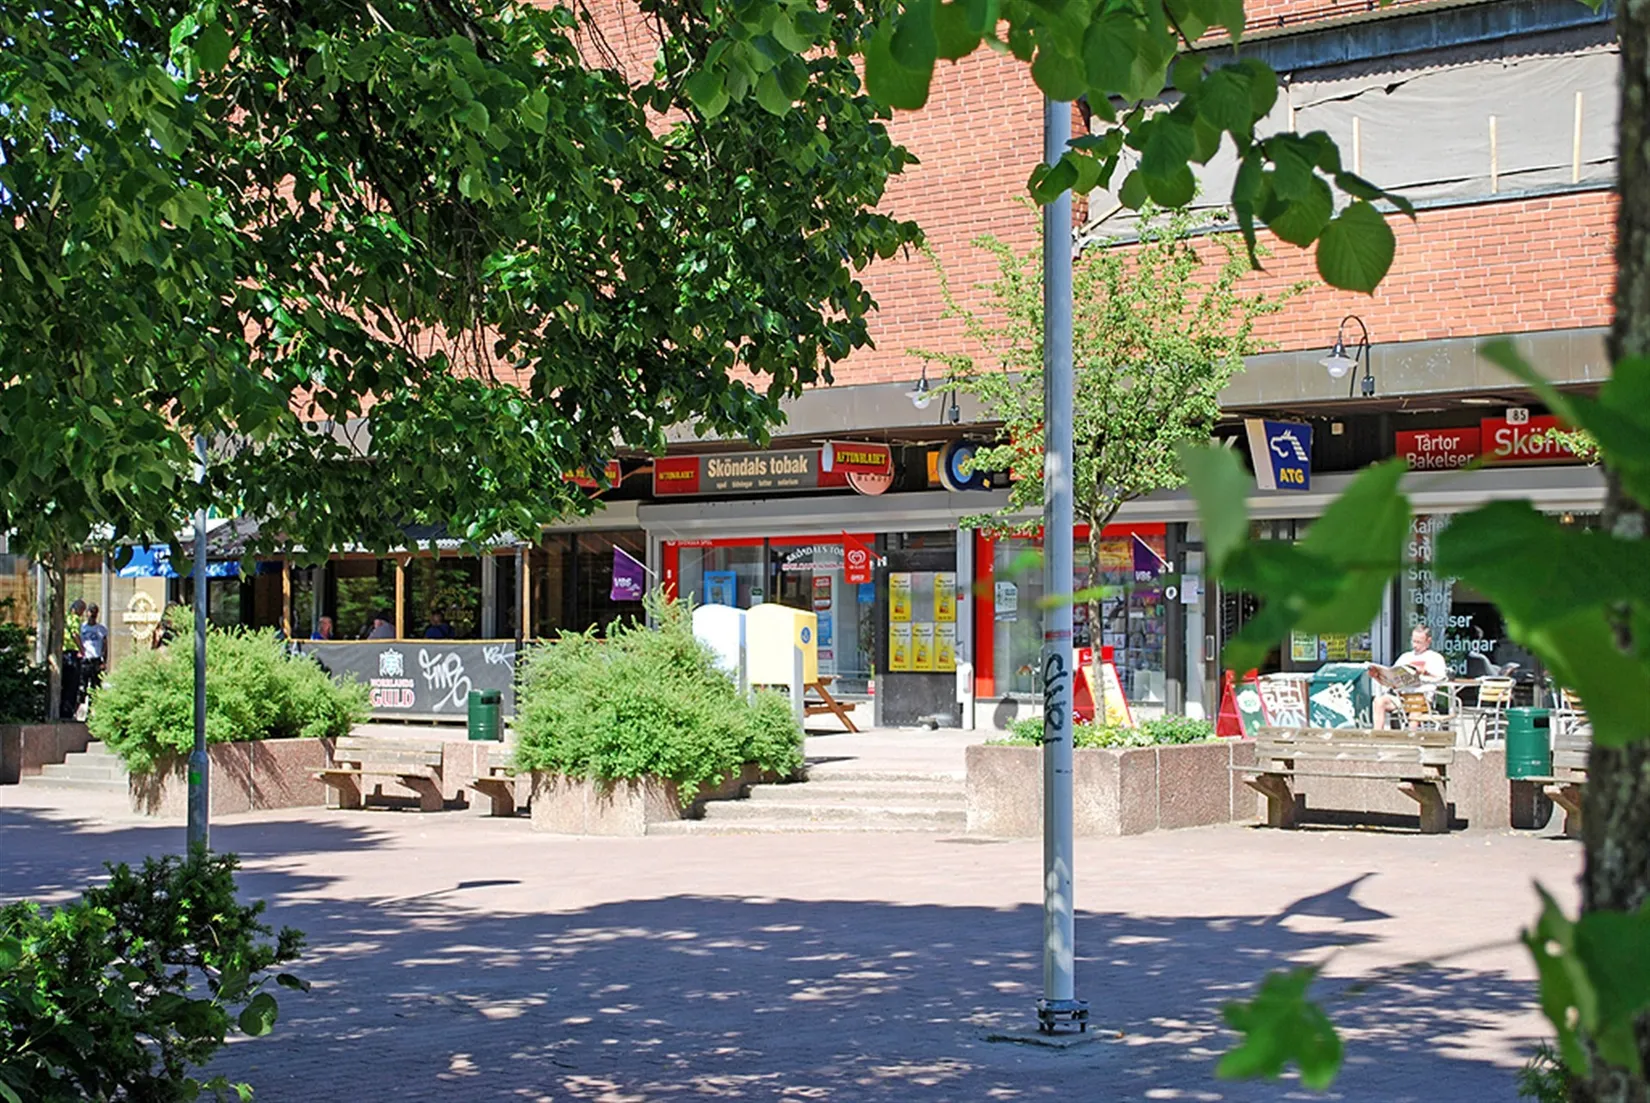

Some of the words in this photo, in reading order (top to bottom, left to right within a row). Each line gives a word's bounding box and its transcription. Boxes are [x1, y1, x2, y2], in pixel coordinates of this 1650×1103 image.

[1512, 409, 1527, 421] 85
[1414, 433, 1460, 452] Tårtor
[707, 457, 765, 479] Sköndals
[770, 454, 808, 475] tobak
[836, 450, 887, 466] AFTONBLADET
[1406, 452, 1475, 470] Bakelser
[1280, 467, 1304, 484] ATG
[1408, 613, 1474, 628] Bakelser
[369, 688, 416, 708] GULD
